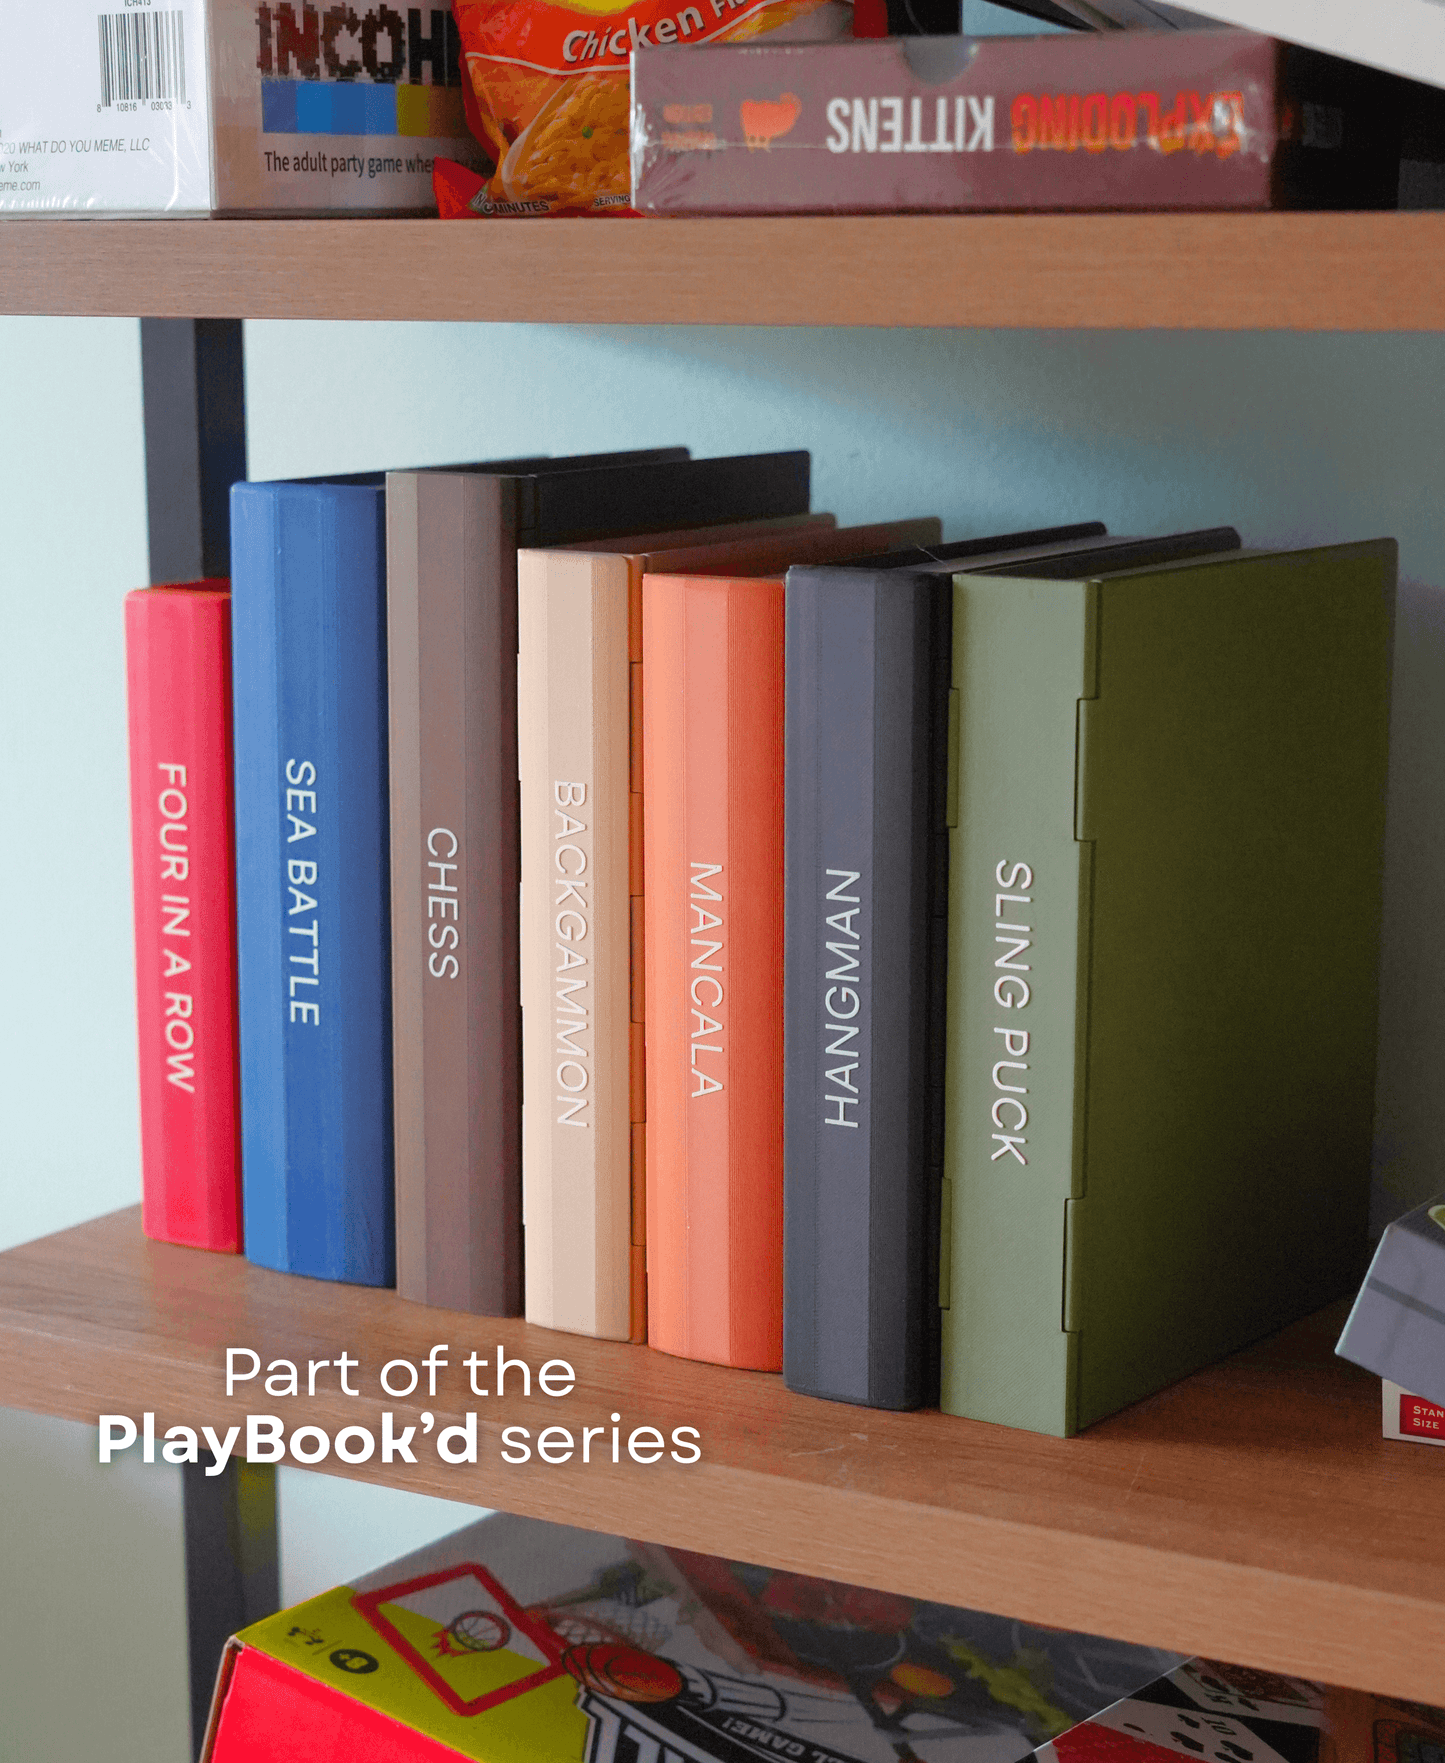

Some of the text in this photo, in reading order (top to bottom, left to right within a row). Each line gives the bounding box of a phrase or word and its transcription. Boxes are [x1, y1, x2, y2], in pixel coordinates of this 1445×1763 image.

[562, 5, 706, 63] Chicken
[116, 102, 138, 112] 10816
[826, 95, 995, 154] KITTENS
[8, 161, 29, 173] York
[18, 140, 48, 154] WHAT
[50, 140, 67, 153] DO
[69, 139, 92, 153] YOU
[94, 138, 127, 153] MEME,
[130, 137, 151, 151] LLC
[264, 151, 290, 172] The
[293, 151, 328, 172] adult
[331, 154, 365, 178] party
[368, 157, 402, 179] game
[494, 200, 551, 214] MINUTES
[593, 195, 631, 207] SERVING
[285, 758, 320, 1027] SEA BATTLE
[426, 827, 460, 980] CHESS
[158, 762, 195, 1094] FOUR IN A ROW
[554, 779, 590, 1129] BACKGAMMON
[690, 861, 724, 1099] MANCALA
[824, 868, 862, 1129] HANGMAN
[990, 859, 1034, 1167] SLING PUCK
[1412, 1405, 1445, 1418] STAN
[1412, 1417, 1440, 1430] SIZE
[721, 1716, 806, 1758] GAME!
